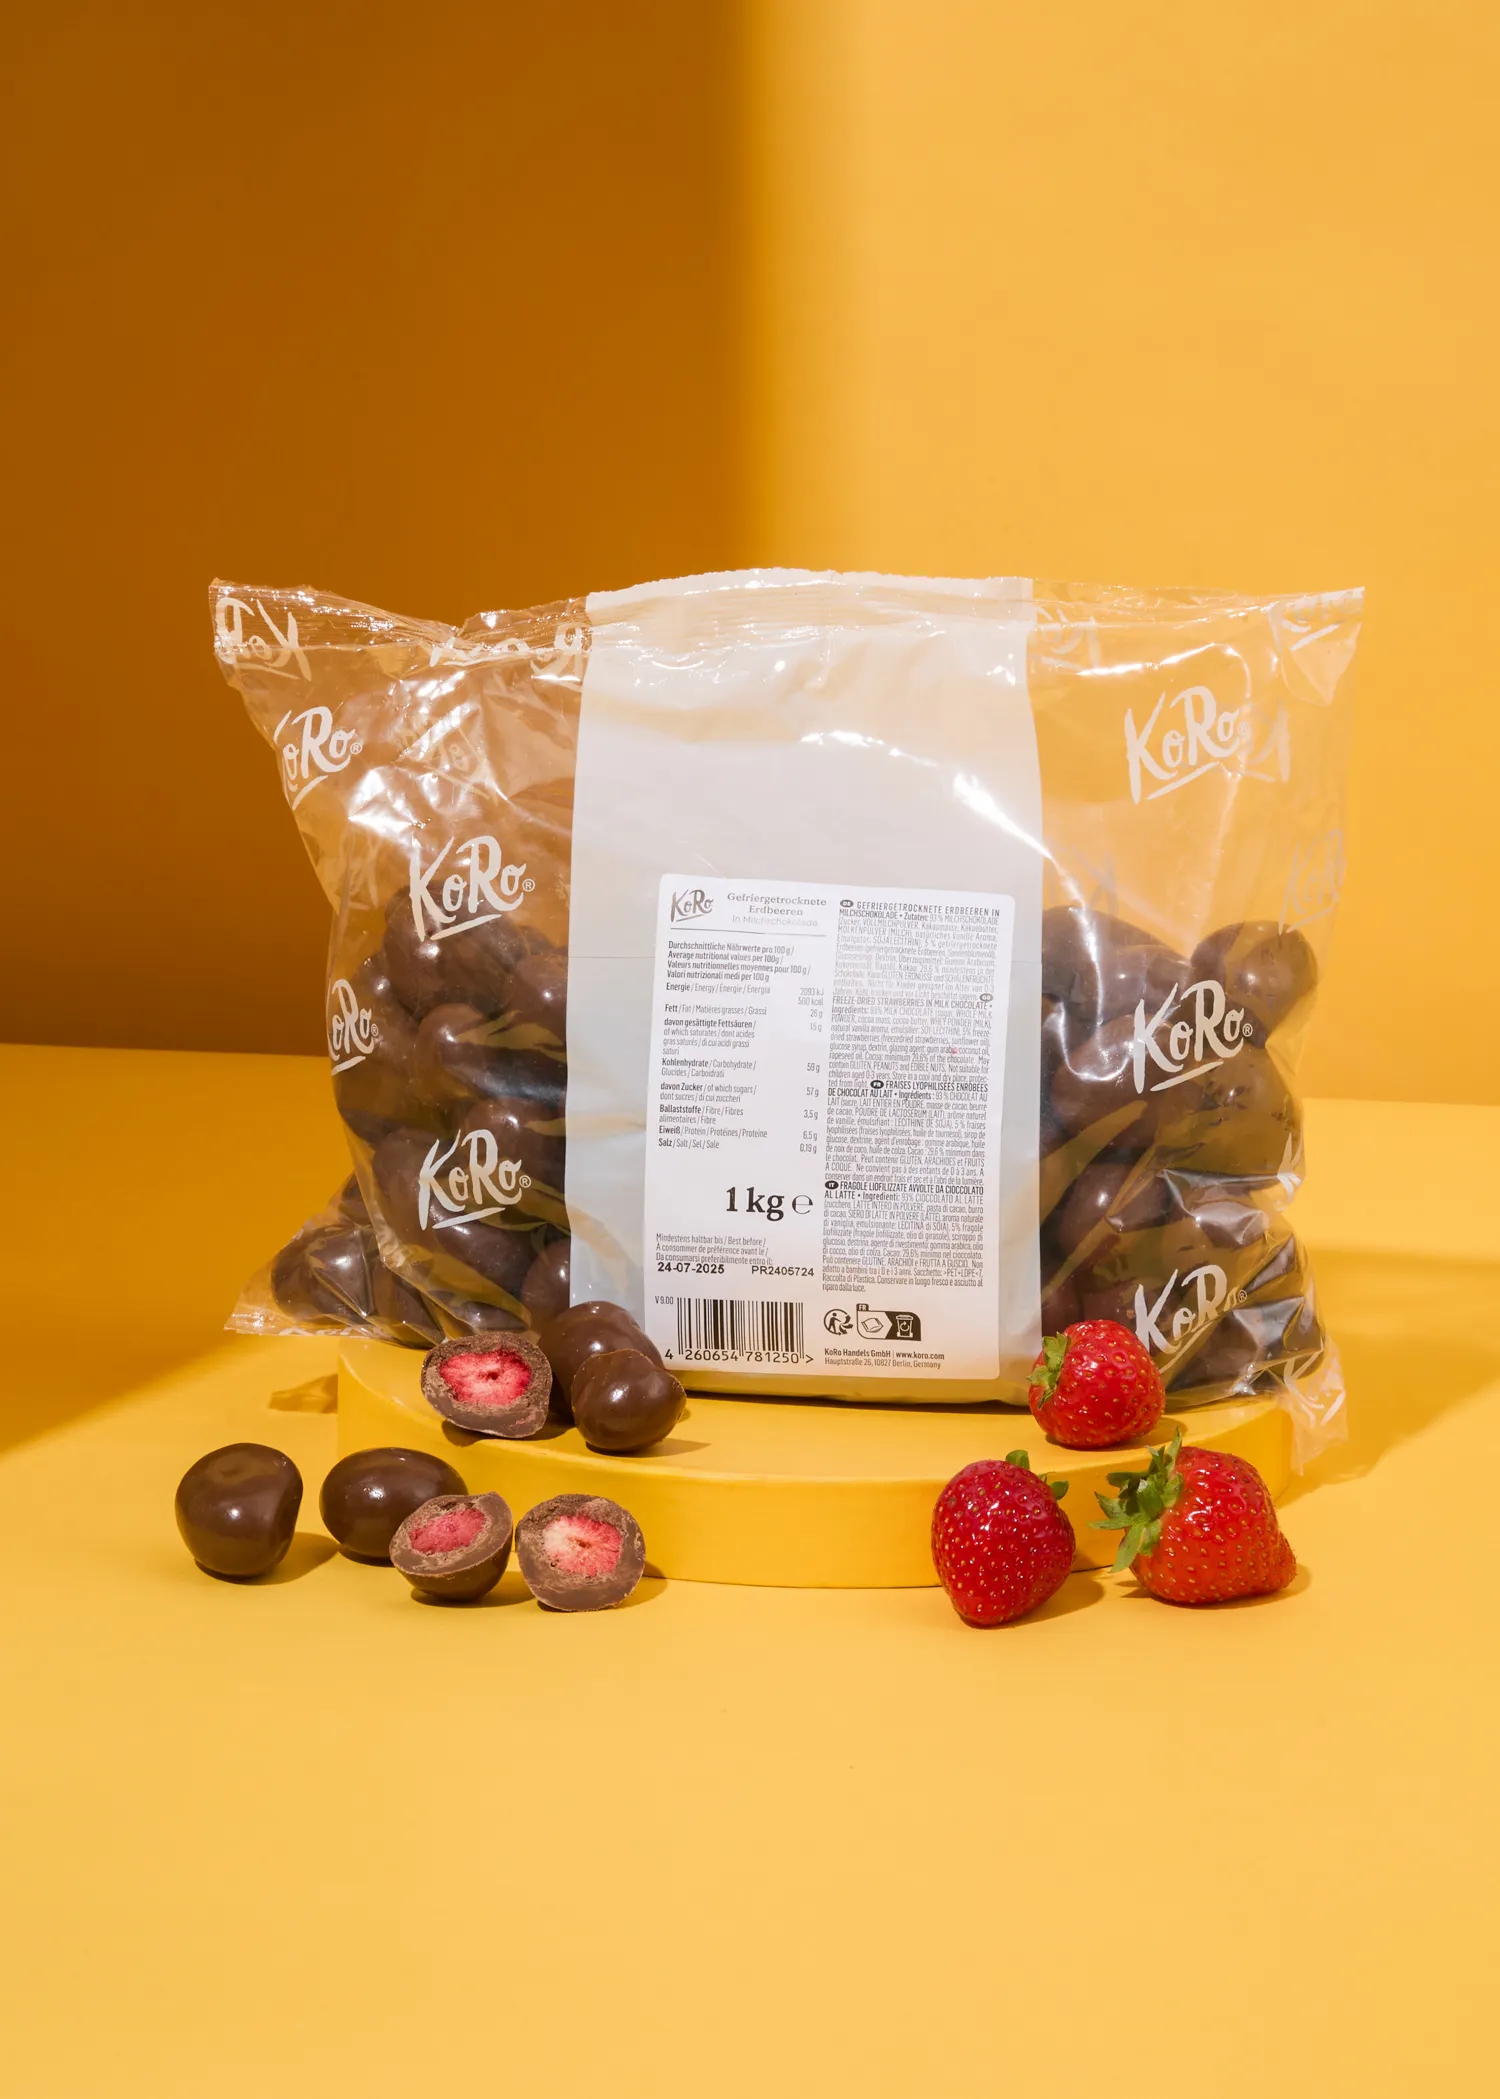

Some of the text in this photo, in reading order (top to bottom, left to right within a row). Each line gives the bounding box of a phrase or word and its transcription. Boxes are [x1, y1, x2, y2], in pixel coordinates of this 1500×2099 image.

[727, 894, 827, 906] Gefriergetrocknete
[671, 888, 714, 924] KoRo
[748, 906, 804, 916] Erdbeeren
[857, 902, 1000, 917] GEFRIERGETROCKNETE ERDBEEREN IN
[839, 909, 898, 919] MILCHSCHOKOLADE
[668, 941, 726, 951] Durchschnittliche
[727, 943, 761, 952] Nährwerte
[761, 946, 773, 955] pro
[774, 945, 785, 954] 100
[668, 950, 694, 960] Average
[695, 951, 729, 961] nutritional
[730, 953, 751, 961] values
[752, 955, 763, 964] per
[667, 960, 691, 969] Valeurs
[692, 961, 739, 971] nutritionnelles
[740, 964, 773, 973] moyennes
[774, 965, 789, 974] pour
[790, 965, 802, 973] 100
[667, 970, 686, 978] Valori
[686, 970, 723, 979] nutrizionali
[724, 971, 740, 980] medi
[741, 973, 752, 982] per
[666, 982, 690, 993] Energie
[695, 983, 715, 993] Energy
[747, 985, 770, 995] Energia
[811, 997, 824, 1006] kcal
[877, 997, 924, 1007] STRAWBERRIES
[926, 999, 932, 1007] IN
[934, 999, 949, 1008] MILK
[951, 1001, 987, 1009] CHOCOLATE
[665, 1004, 678, 1012] Fett
[682, 1004, 691, 1012] Fat
[721, 1006, 744, 1015] grasses
[748, 1006, 767, 1015] Grassi
[810, 1009, 818, 1017] 26
[664, 1018, 752, 1028] davon gesättigte Fettsäuren
[810, 1023, 817, 1031] 15
[664, 1027, 754, 1038] of which saturates dont acides
[663, 1038, 676, 1046] gras
[702, 1038, 707, 1046] di
[708, 1038, 717, 1046] cui
[717, 1038, 731, 1047] acidi
[732, 1040, 750, 1048] grassi
[663, 1046, 679, 1055] saturi
[662, 1058, 752, 1070] Kohlenhydrate Carbohydrate
[662, 1068, 687, 1077] Glucides
[661, 1082, 753, 1094] davon Zucker of which sugars
[886, 1080, 911, 1089] FRAISES
[806, 1087, 814, 1095] 57
[828, 1087, 836, 1096] DE
[837, 1087, 868, 1097] CHOCOLAT
[870, 1089, 878, 1097] AU
[880, 1089, 893, 1097] LAIT
[660, 1092, 741, 1102] dont sucres di cui zuccheri
[659, 1104, 744, 1115] Ballaststoffe Fibre Fibres
[659, 1115, 716, 1124] alimentaires Fibre
[659, 1125, 680, 1135] Eiweiß
[684, 1127, 706, 1135] Protein
[658, 1138, 719, 1148] Salz Salt Sel Sale
[840, 1181, 868, 1190] FRAGOLE
[869, 1182, 907, 1192] LIOFILIZZATE
[908, 1184, 934, 1193] AVVOLTE
[935, 1185, 944, 1193] DA
[945, 1185, 984, 1195] CIOCCOLATO
[824, 1190, 834, 1198] AL
[835, 1190, 855, 1199] LATTE
[915, 1193, 953, 1202] CIOCCOLATO
[955, 1195, 963, 1203] AL
[964, 1195, 983, 1204] LATTE
[726, 1186, 738, 1211] 1
[746, 1187, 784, 1221] kg
[656, 1233, 762, 1245] Mindestens haltbar bis Best before
[662, 1244, 697, 1252] consommer
[698, 1245, 706, 1253] de
[740, 1247, 758, 1255] avant
[758, 1247, 764, 1255] le
[656, 1253, 665, 1261] Da
[749, 1257, 765, 1265] entro
[657, 1262, 815, 1276] 24-07-2025 PR2405724
[665, 1350, 674, 1359] 4
[685, 1349, 738, 1361] 260654
[745, 1352, 799, 1363] 781250
[824, 1348, 842, 1356] KoRo
[843, 1349, 870, 1357] Handels
[895, 1351, 944, 1359] www.koro.com
[824, 1357, 863, 1366] Hauptstraße
[913, 1361, 941, 1369] Germany
